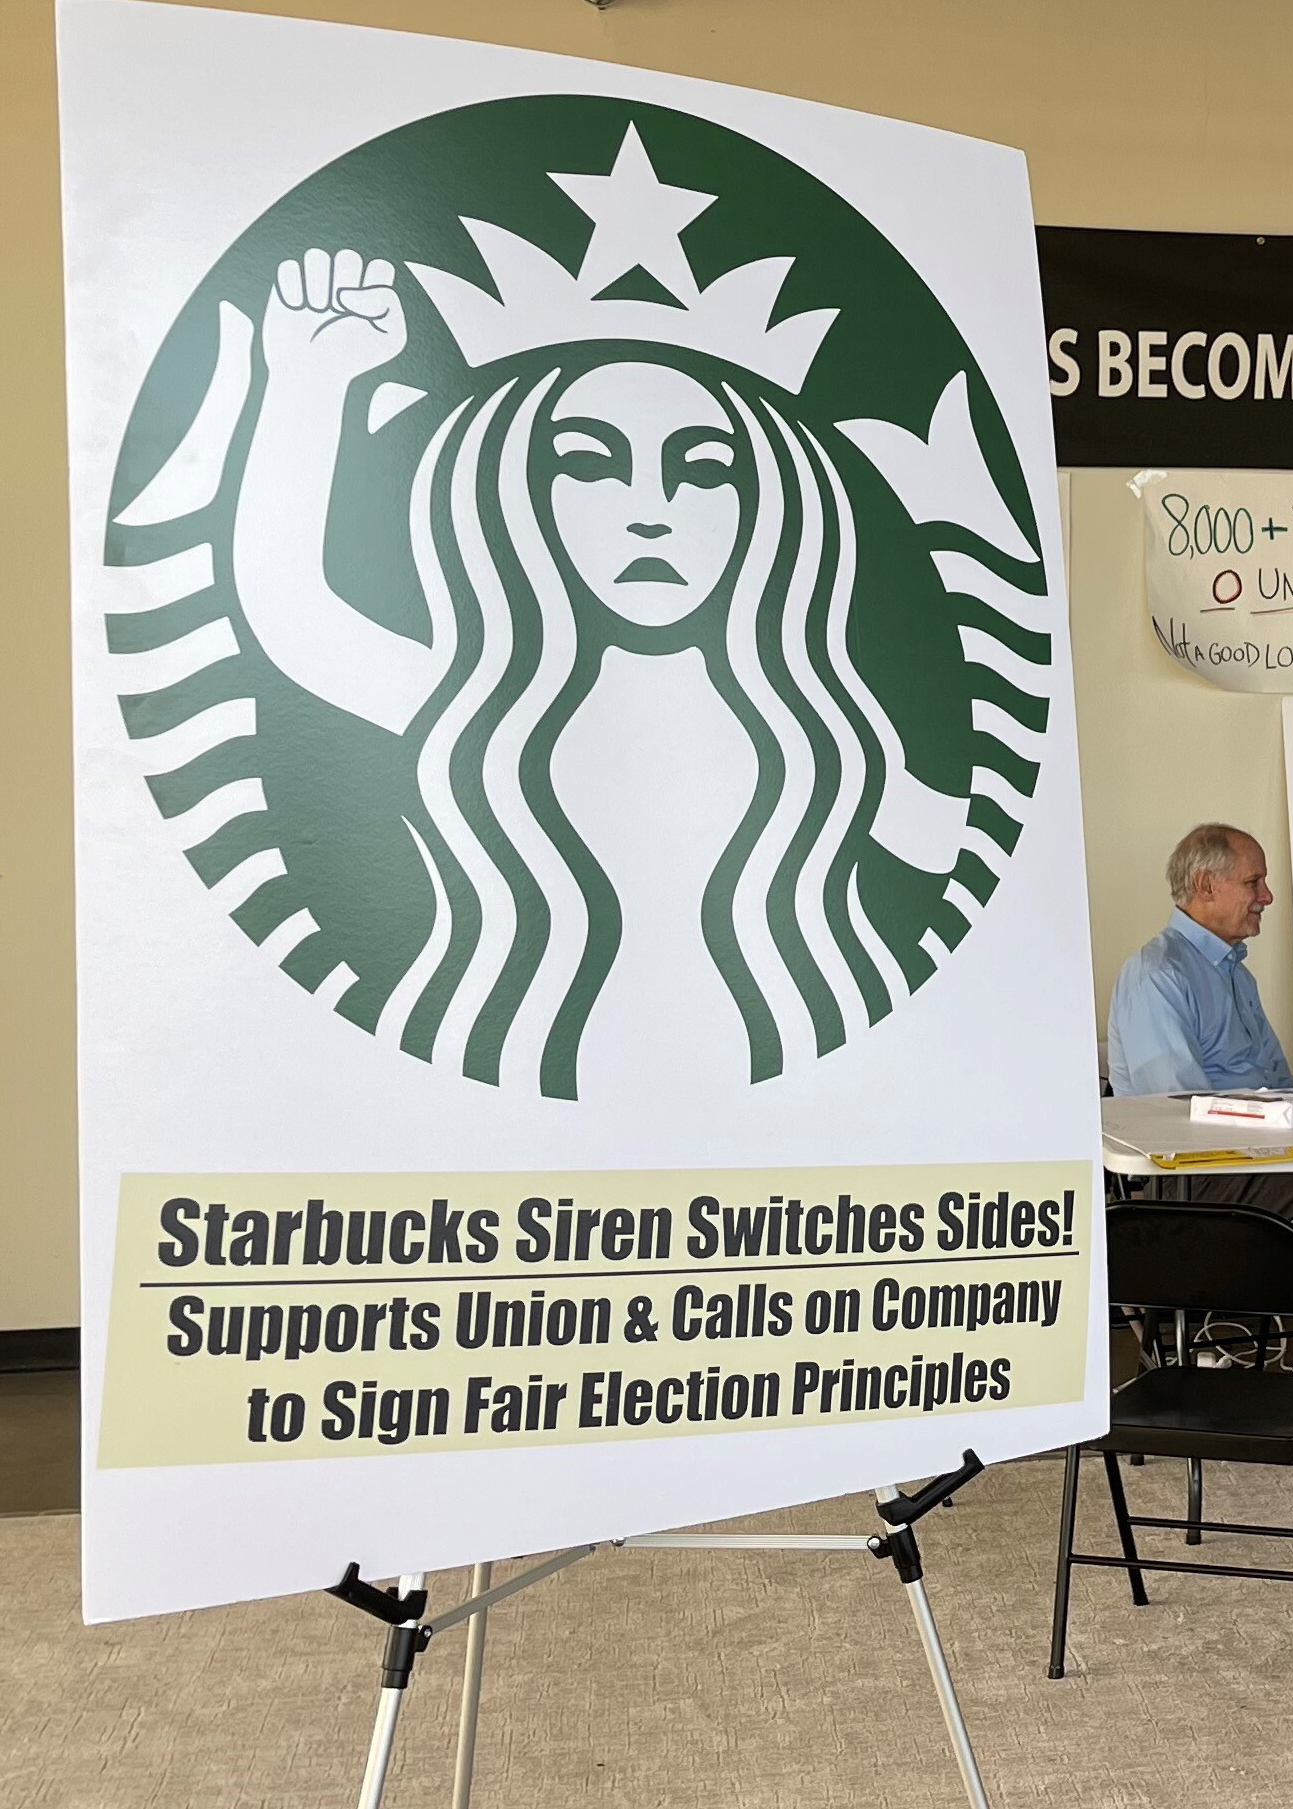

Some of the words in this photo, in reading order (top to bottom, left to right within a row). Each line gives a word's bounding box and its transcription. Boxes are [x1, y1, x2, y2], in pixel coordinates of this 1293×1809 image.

[1209, 641, 1260, 667] GOOD
[157, 1197, 500, 1267] Starbucks
[515, 1197, 672, 1263] Siren
[686, 1194, 926, 1259] Switches
[937, 1190, 1076, 1251] Sides!
[167, 1295, 441, 1361] Supports
[455, 1290, 611, 1350] Union
[623, 1295, 659, 1344] &
[672, 1283, 793, 1342] Calls
[804, 1287, 861, 1336] on
[872, 1277, 1062, 1333] Company
[247, 1387, 306, 1443] to
[320, 1380, 450, 1446] Sign
[463, 1374, 567, 1435] Fair
[578, 1366, 780, 1428] Election
[791, 1352, 1011, 1415] Principles
